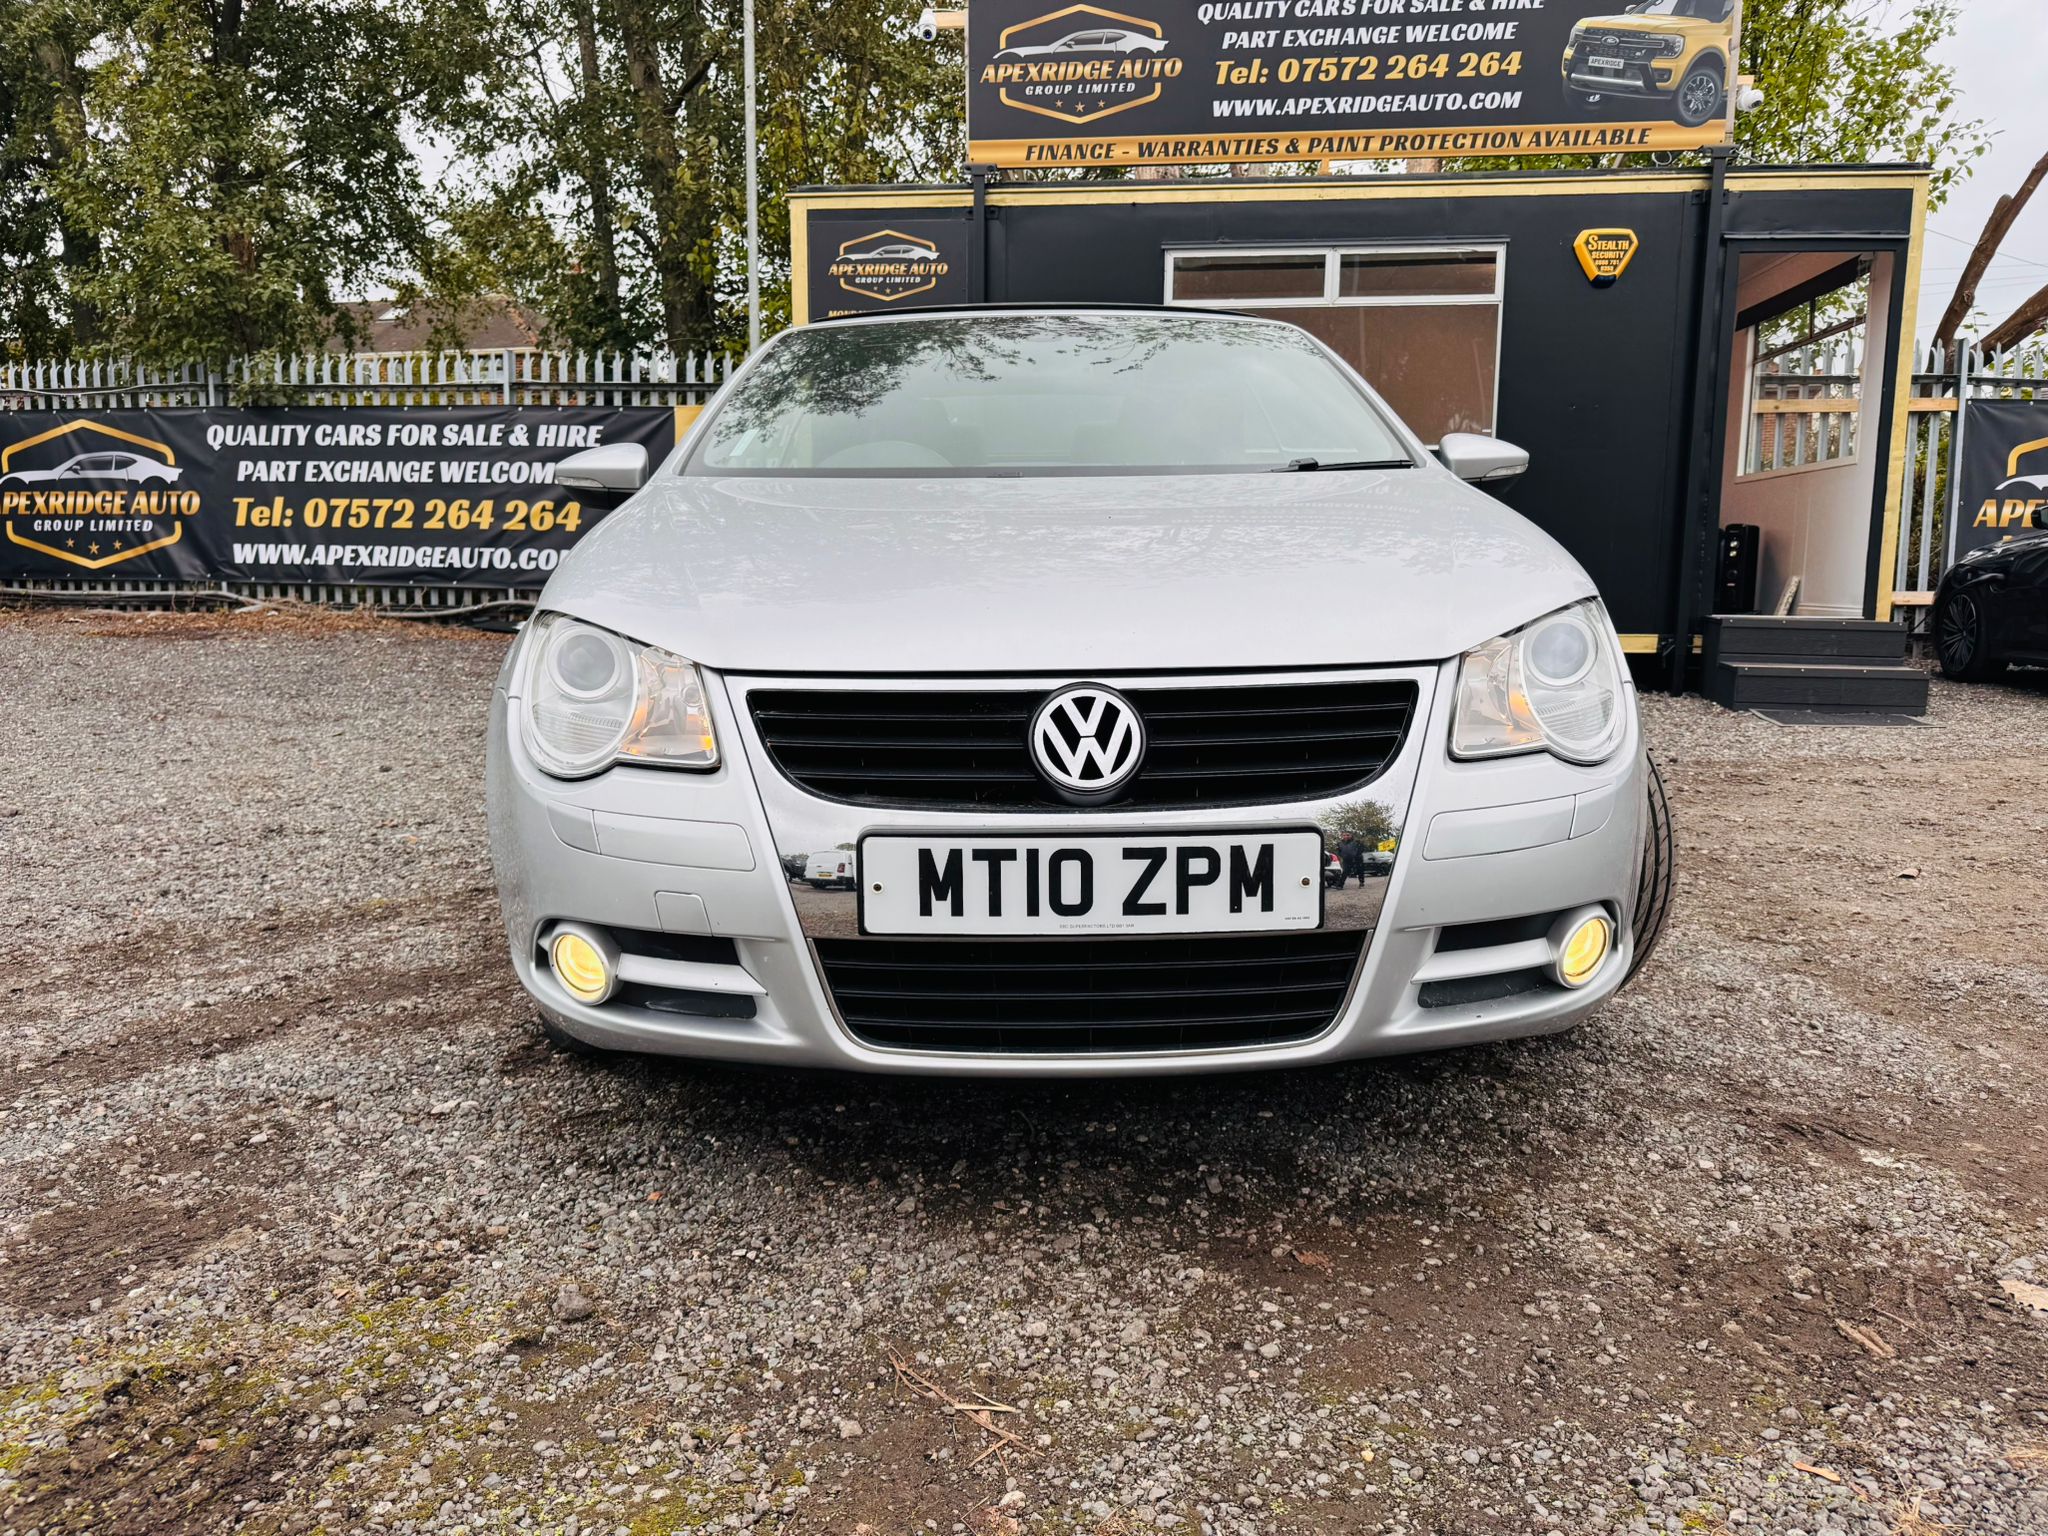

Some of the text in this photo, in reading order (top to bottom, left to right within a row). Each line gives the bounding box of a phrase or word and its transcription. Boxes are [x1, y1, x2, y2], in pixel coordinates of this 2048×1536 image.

[1198, 0, 1291, 25] QUALITY
[1294, 0, 1356, 17] CARS
[1360, 0, 1405, 15] FOR
[1409, 0, 1464, 13] SALE
[1222, 22, 1519, 49] PART EXCHANGE WELCOME
[979, 57, 1183, 83] APEXRIDGE AUTO
[1216, 51, 1522, 85] Tel: 07572 264 264
[1590, 56, 1622, 68] APEXRIDGE
[1025, 82, 1136, 96] GROUP LIMITED
[1213, 91, 1522, 117] WWW.APEXRIDGEAUTO.COM
[1025, 142, 1116, 160] FINANCE
[1138, 138, 1279, 158] WARRANTIES
[1285, 138, 1300, 154] &
[1308, 135, 1374, 153] PAINT
[1379, 131, 1523, 151] PROTECTION
[1527, 128, 1652, 147] AVAILABLE
[1592, 251, 1625, 259] SECURITY
[828, 262, 949, 276] APEXRIDGE AUTO
[207, 424, 603, 451] QUALITY CARS FOR SALE & HIRE
[237, 461, 558, 484] PART EXCHANGE WELCOM
[0, 490, 201, 515] PEXRIDGE AUTO
[232, 496, 582, 532] Tel: 07572 264 264
[34, 519, 154, 532] GROUP LIMITED
[918, 844, 1275, 917] MT10 ZPM
